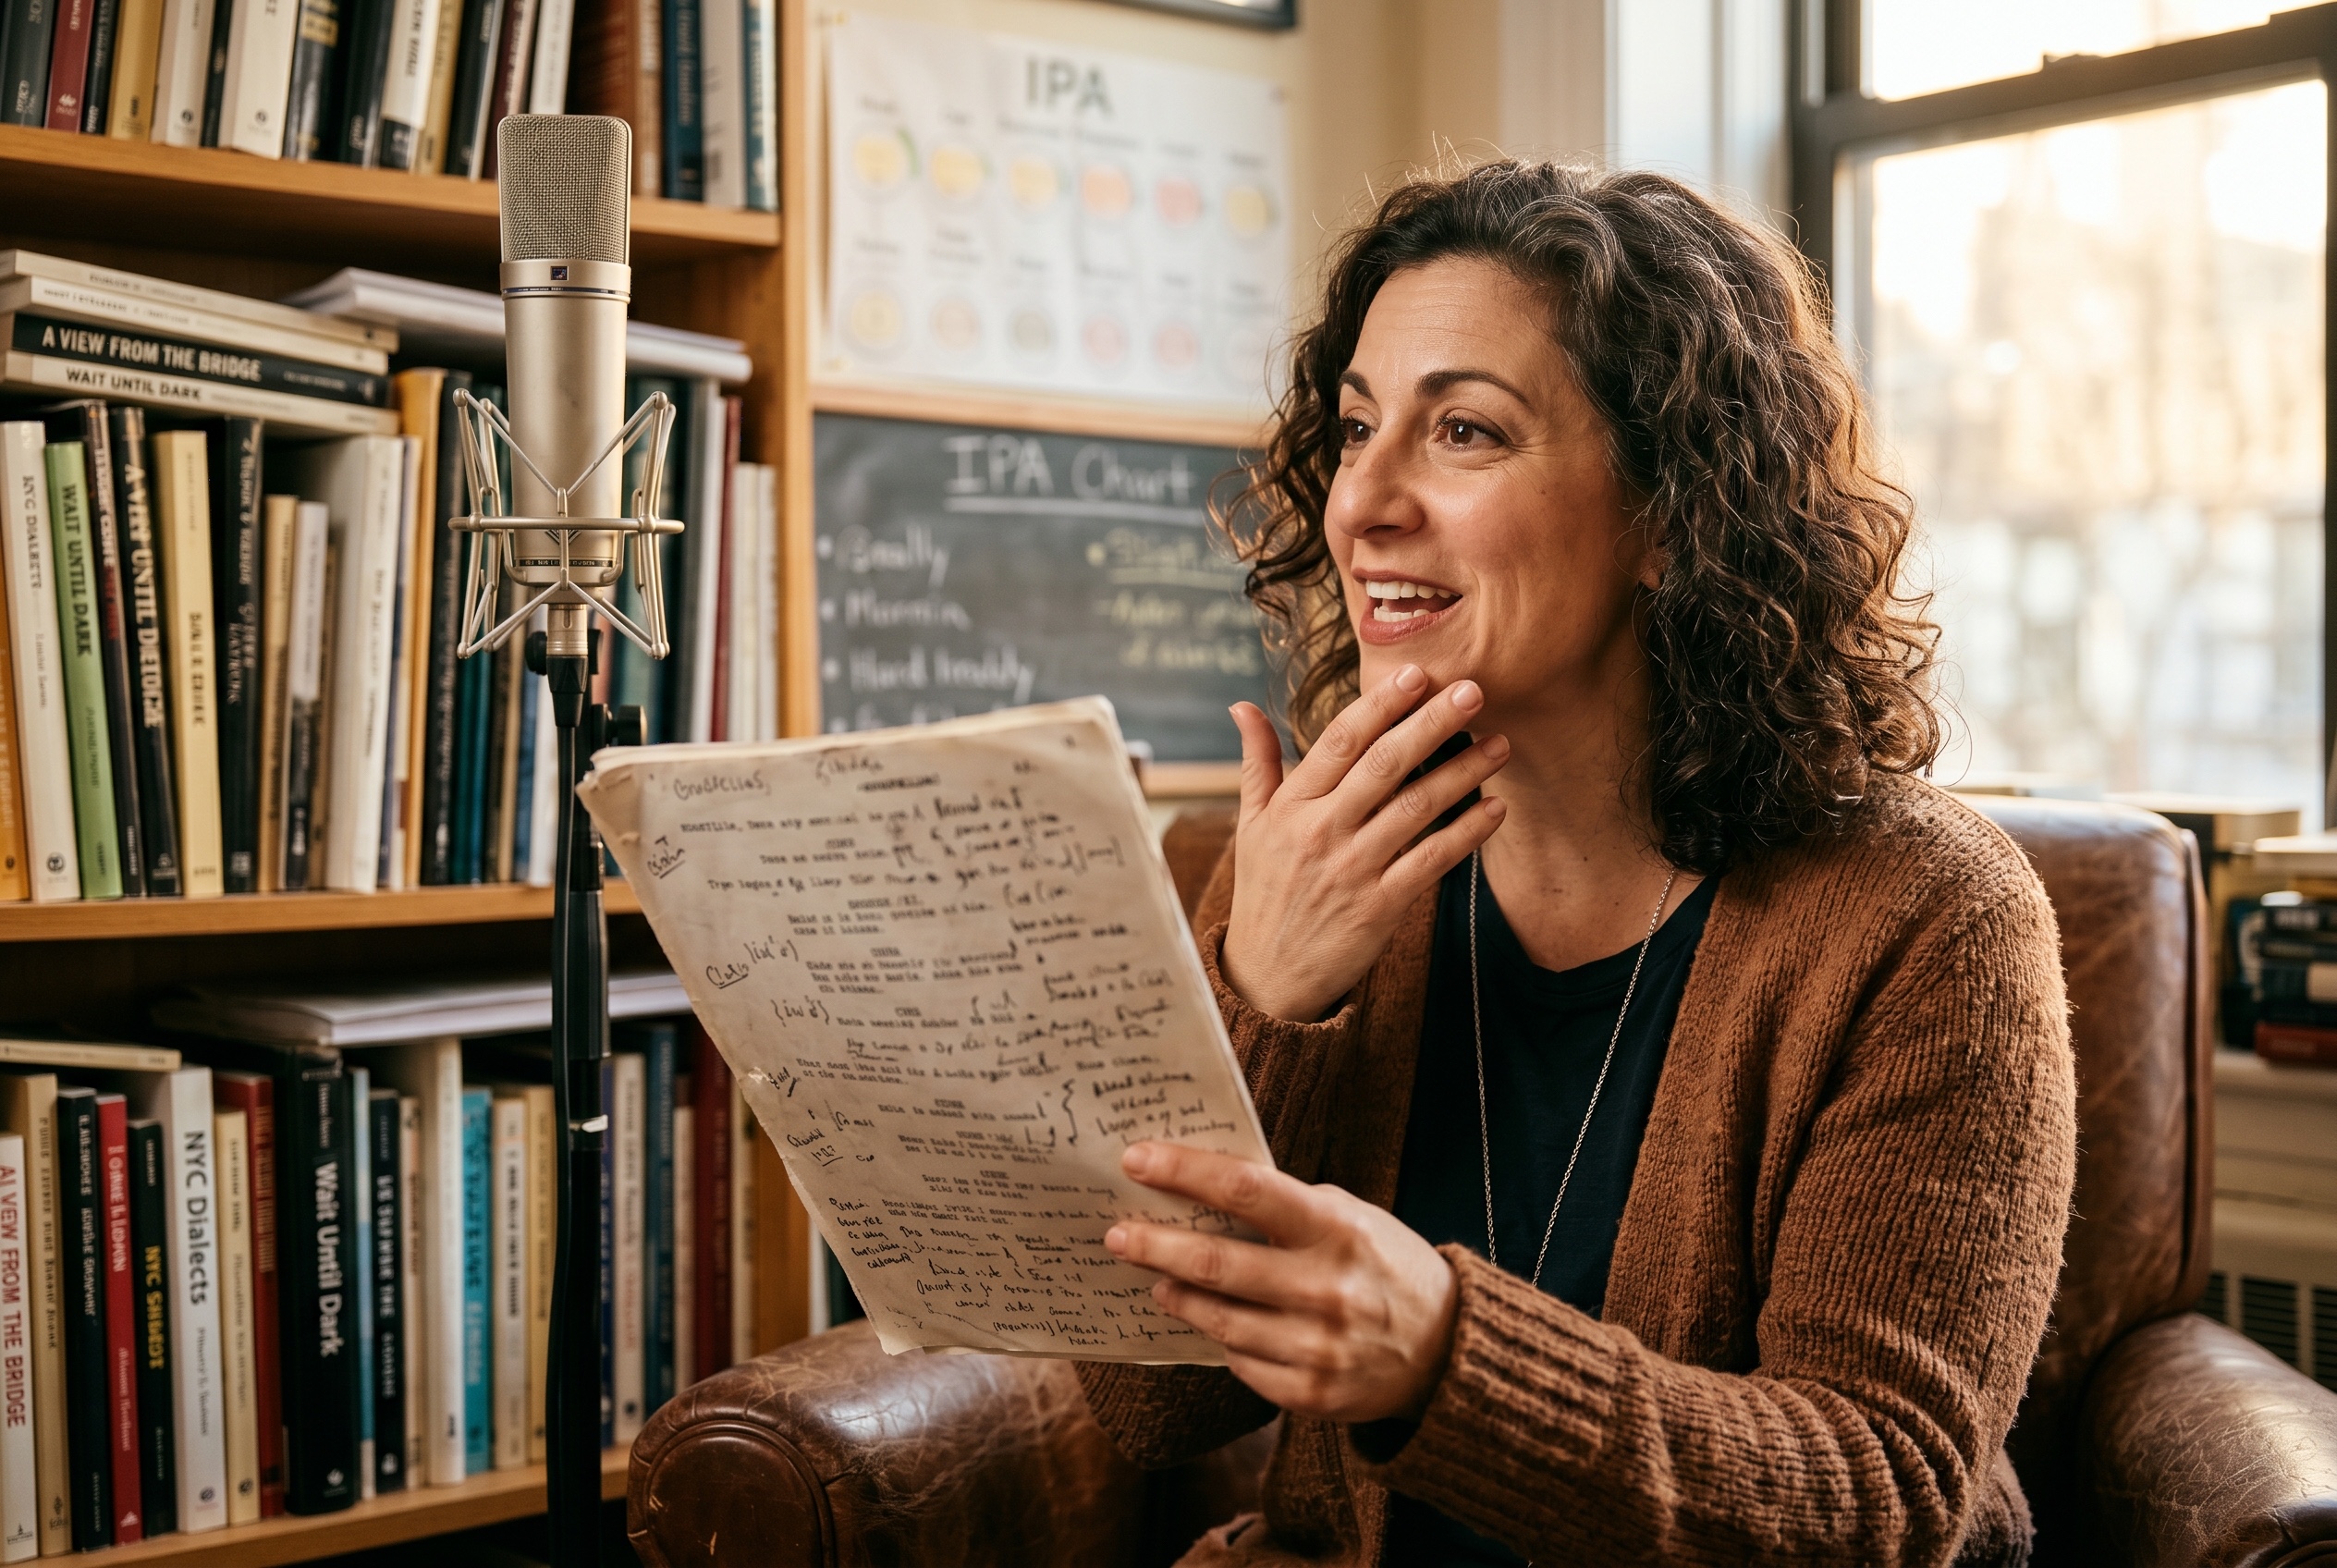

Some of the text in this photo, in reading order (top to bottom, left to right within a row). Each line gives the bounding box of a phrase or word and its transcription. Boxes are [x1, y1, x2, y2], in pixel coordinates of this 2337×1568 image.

[1025, 55, 1115, 119] IPA
[43, 325, 55, 349] A
[60, 328, 104, 355] VIEW
[109, 335, 158, 364] FROM
[163, 345, 195, 372] THE
[199, 351, 263, 382] BRIDGE
[66, 366, 202, 400] WAIT UNTIL DARK
[941, 435, 1055, 496] IPA
[62, 484, 92, 657] WAIT UNTIL DARK
[131, 548, 157, 624] UNTIL
[184, 1131, 210, 1305] NYC Dialects
[2, 1247, 21, 1305] FROM
[315, 1162, 345, 1357] Wait Until Dark
[4, 1311, 23, 1349] THE
[6, 1354, 26, 1427] BRIDGE
